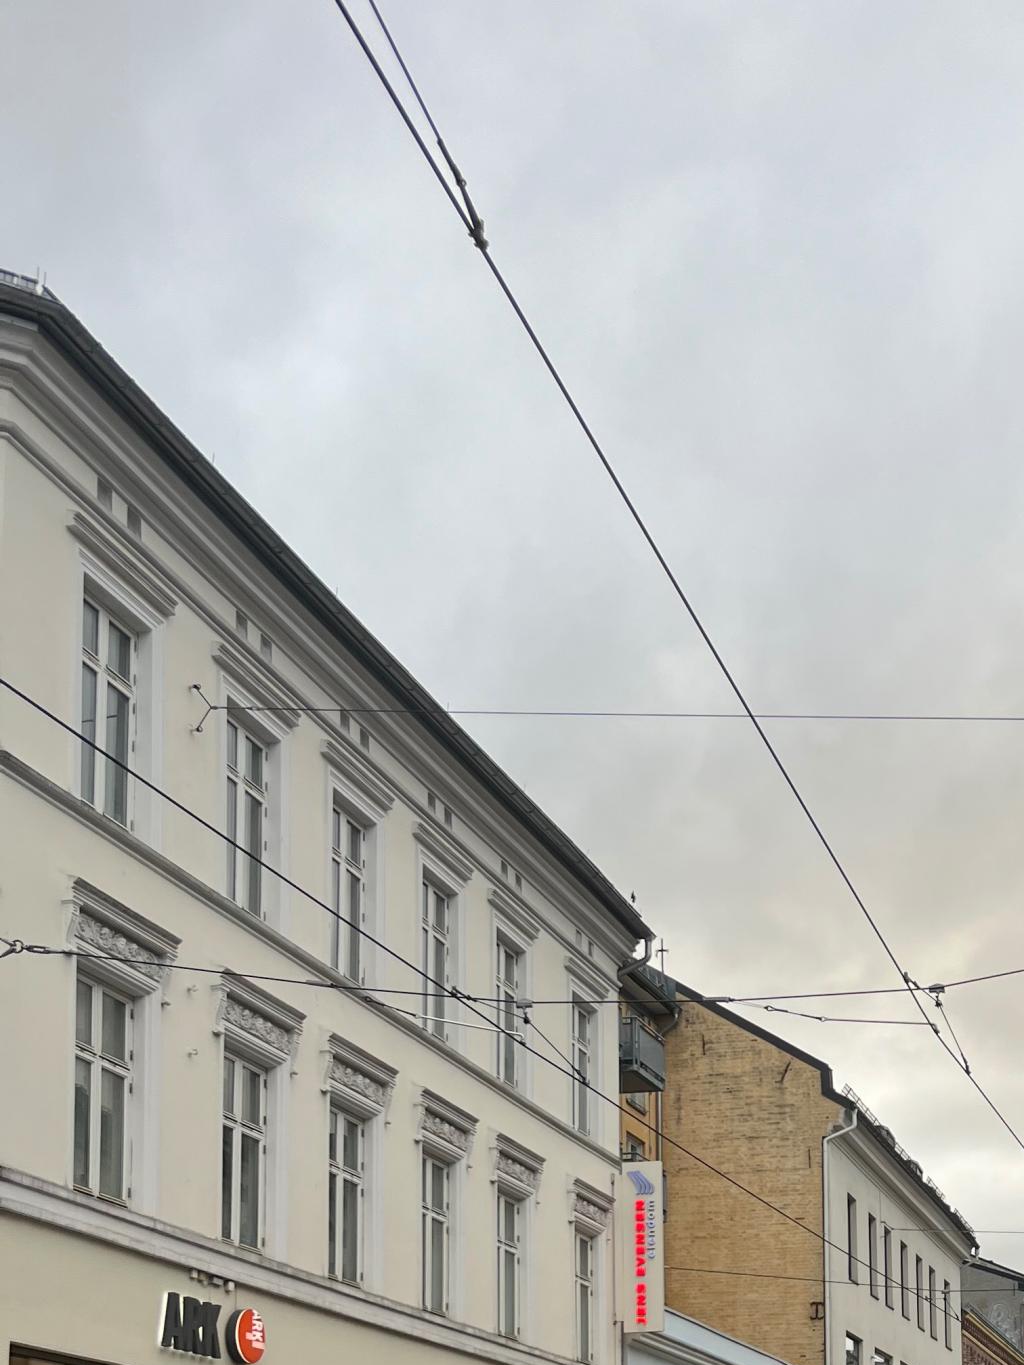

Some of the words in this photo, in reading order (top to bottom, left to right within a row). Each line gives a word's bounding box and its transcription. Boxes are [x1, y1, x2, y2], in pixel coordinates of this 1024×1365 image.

[635, 1200, 646, 1277] EVENSEN
[647, 1201, 656, 1260] eiendom
[160, 1290, 222, 1360] ARK
[636, 1283, 647, 1326] JENS
